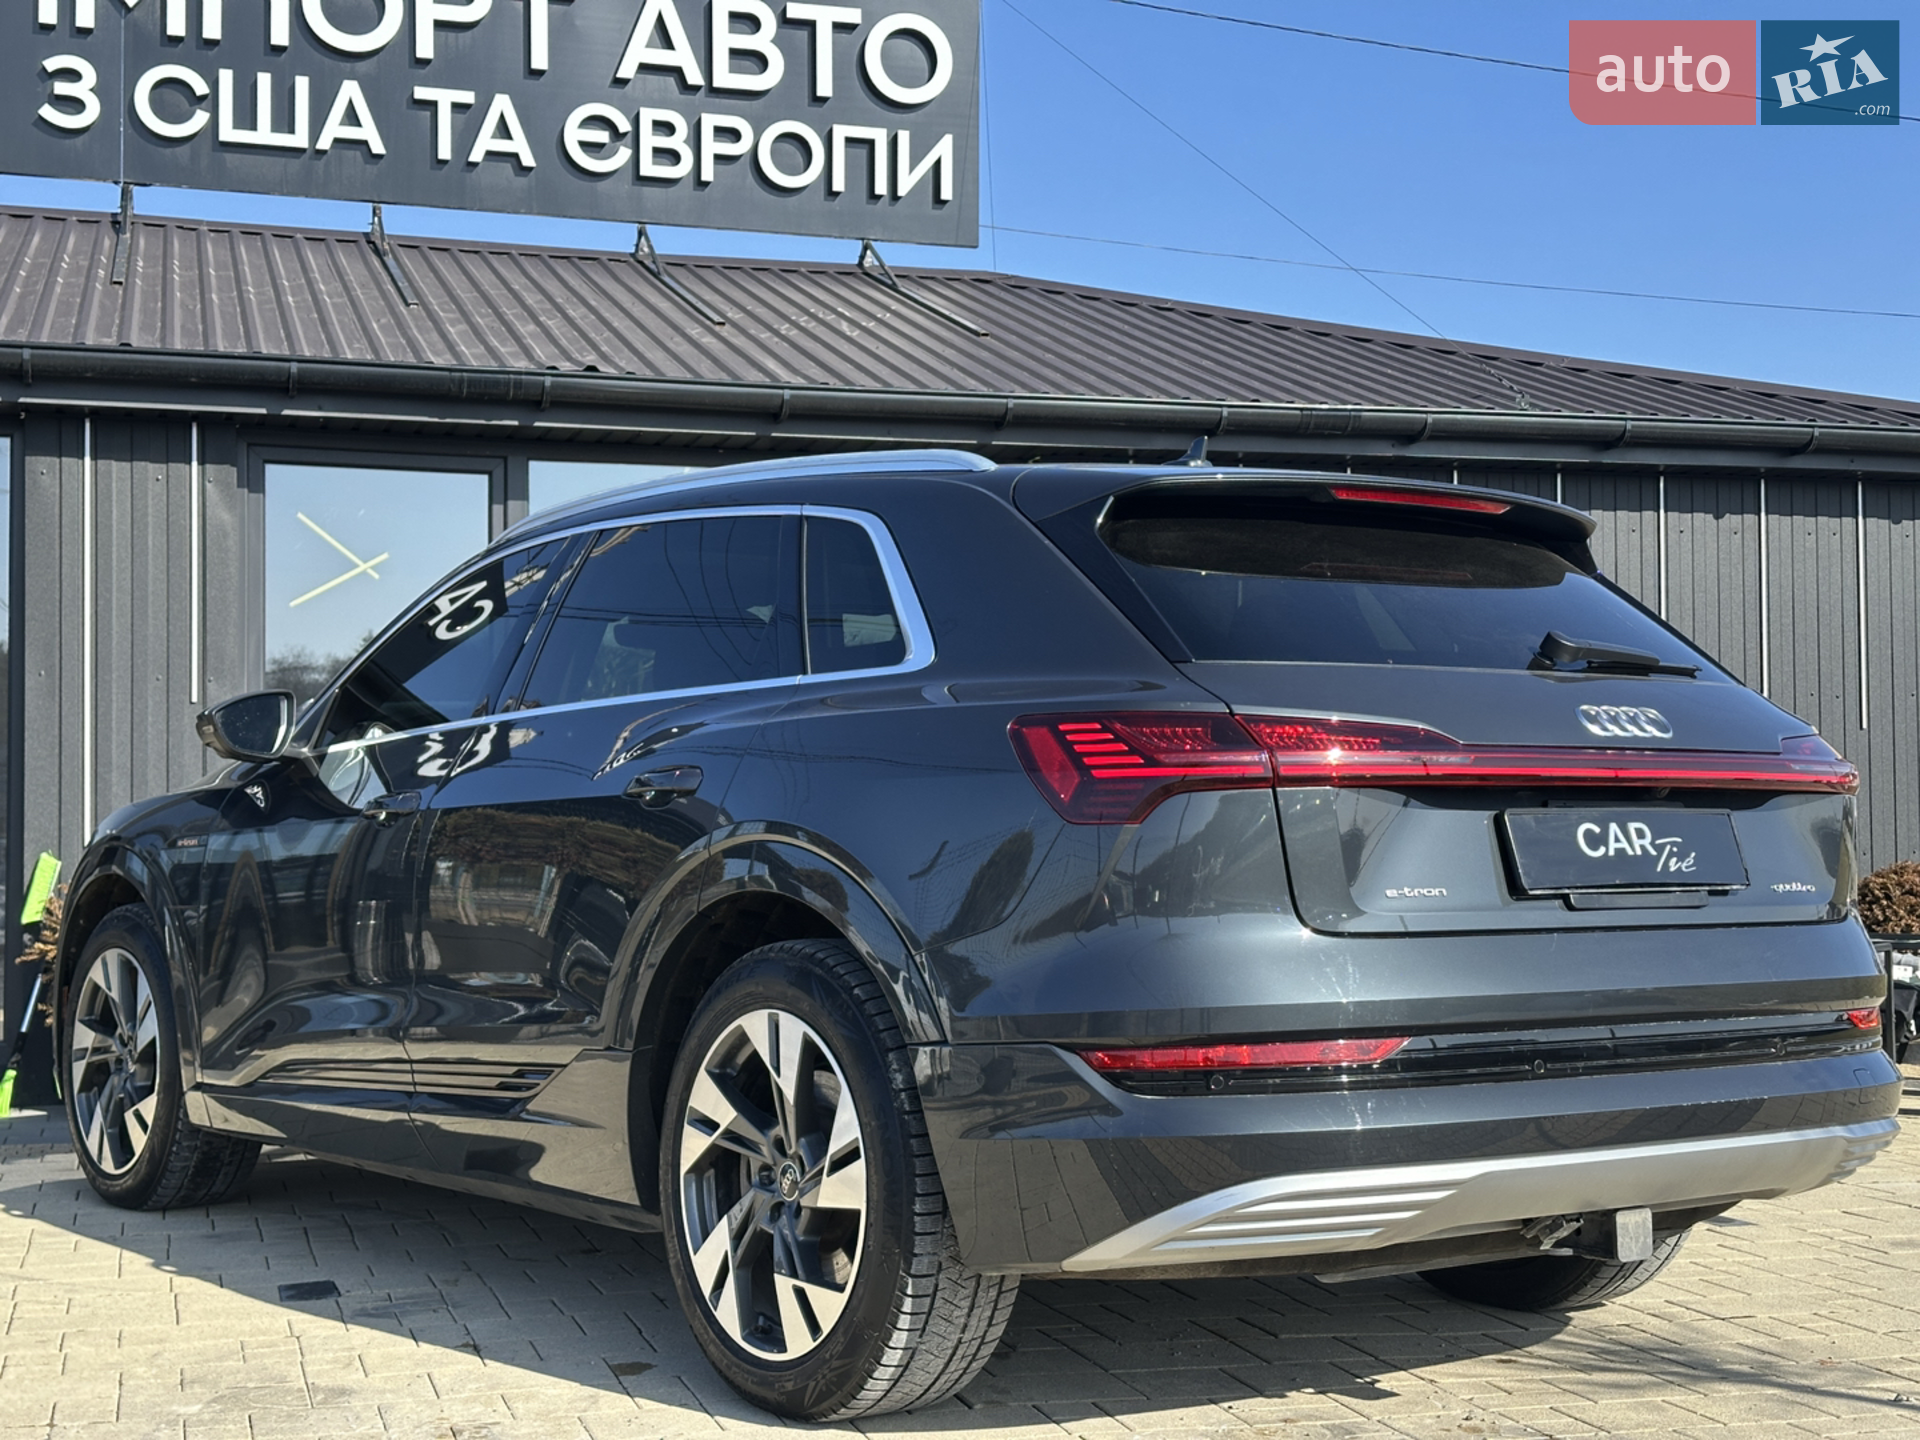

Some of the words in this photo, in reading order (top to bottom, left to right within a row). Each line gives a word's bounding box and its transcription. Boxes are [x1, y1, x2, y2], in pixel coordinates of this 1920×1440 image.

[616, 0, 953, 105] АВТО
[37, 54, 101, 130] З
[133, 64, 387, 156] США
[413, 85, 537, 168] ТА
[563, 102, 953, 201] ЄВРОПИ
[1577, 822, 1658, 858] CAR
[1385, 886, 1447, 899] e-tron
